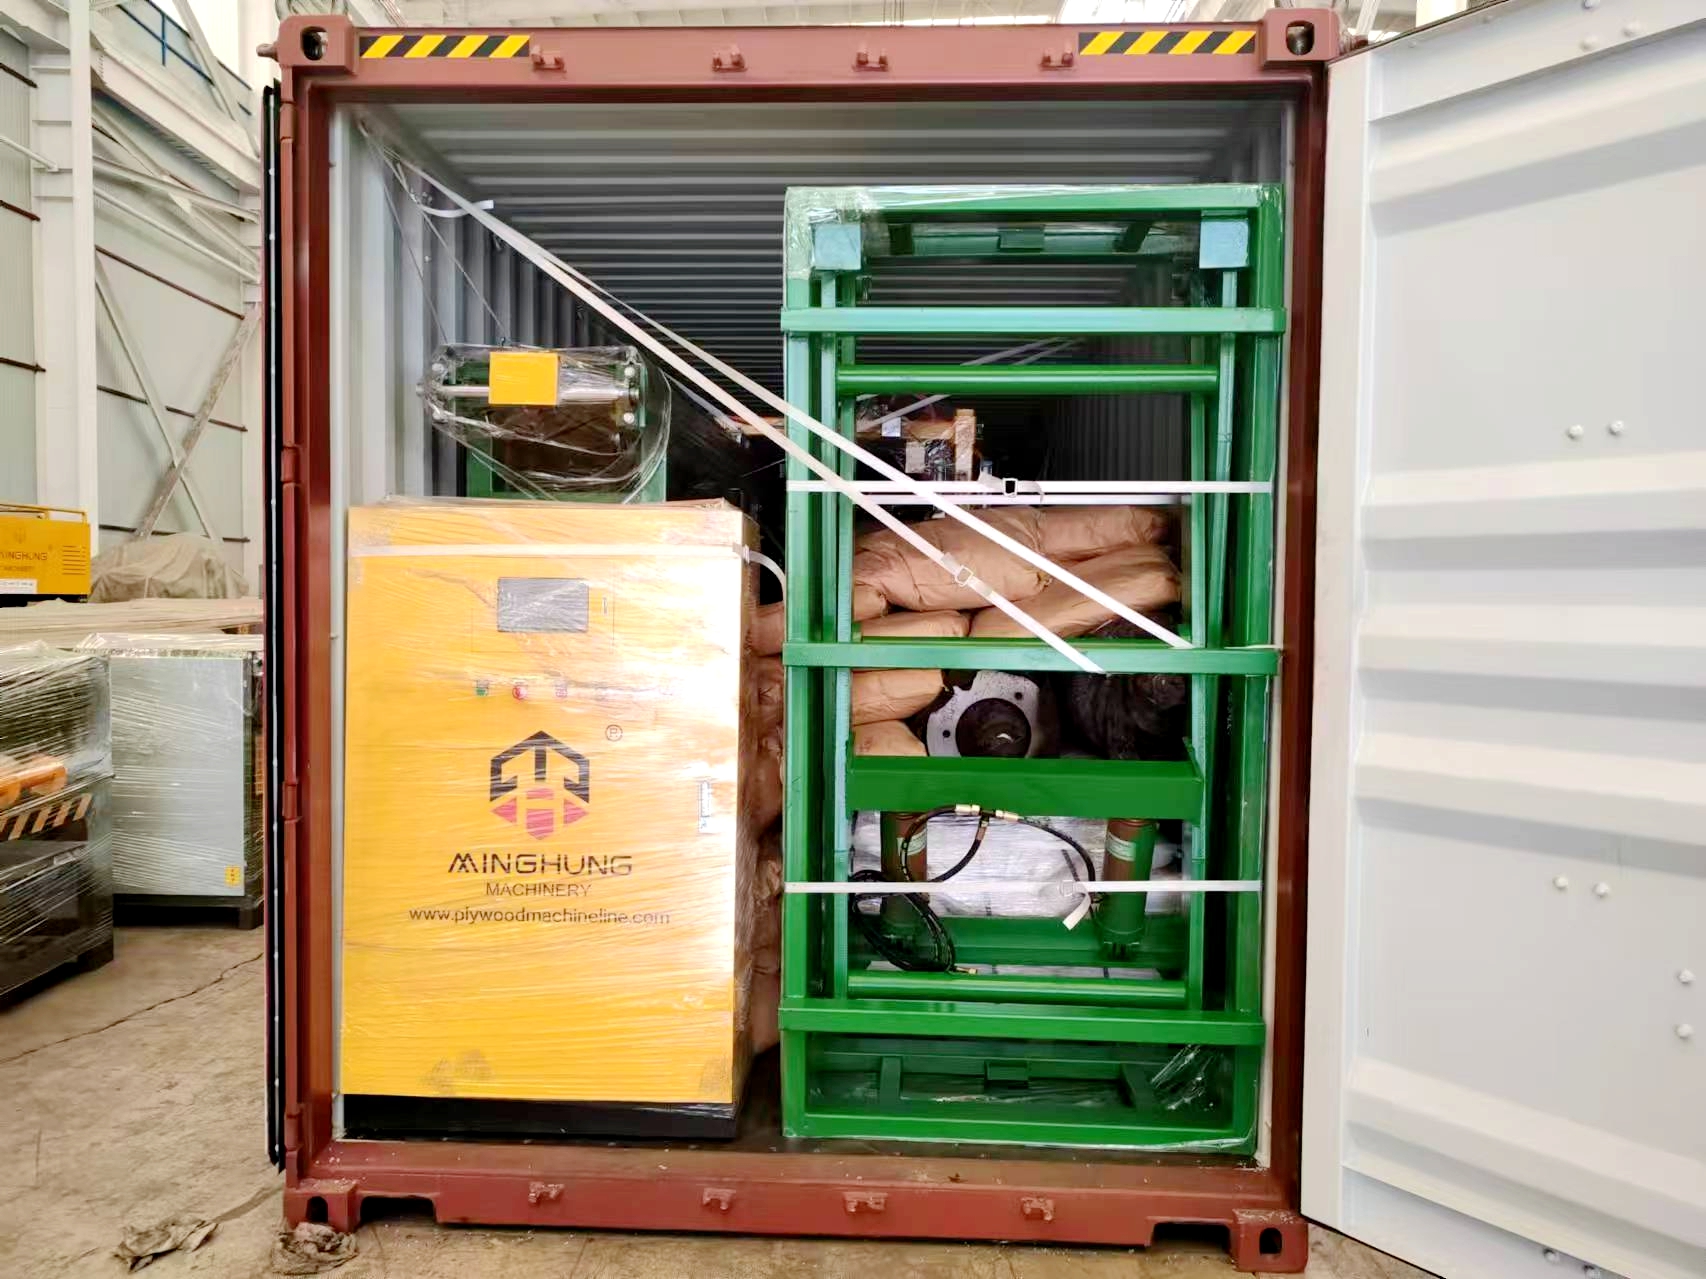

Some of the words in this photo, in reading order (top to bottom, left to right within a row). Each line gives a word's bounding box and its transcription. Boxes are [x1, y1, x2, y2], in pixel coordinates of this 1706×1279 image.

[448, 853, 632, 875] MINGHUNG
[486, 882, 591, 897] MACHINERY
[409, 906, 670, 925] www.plywoodmachineline.com
